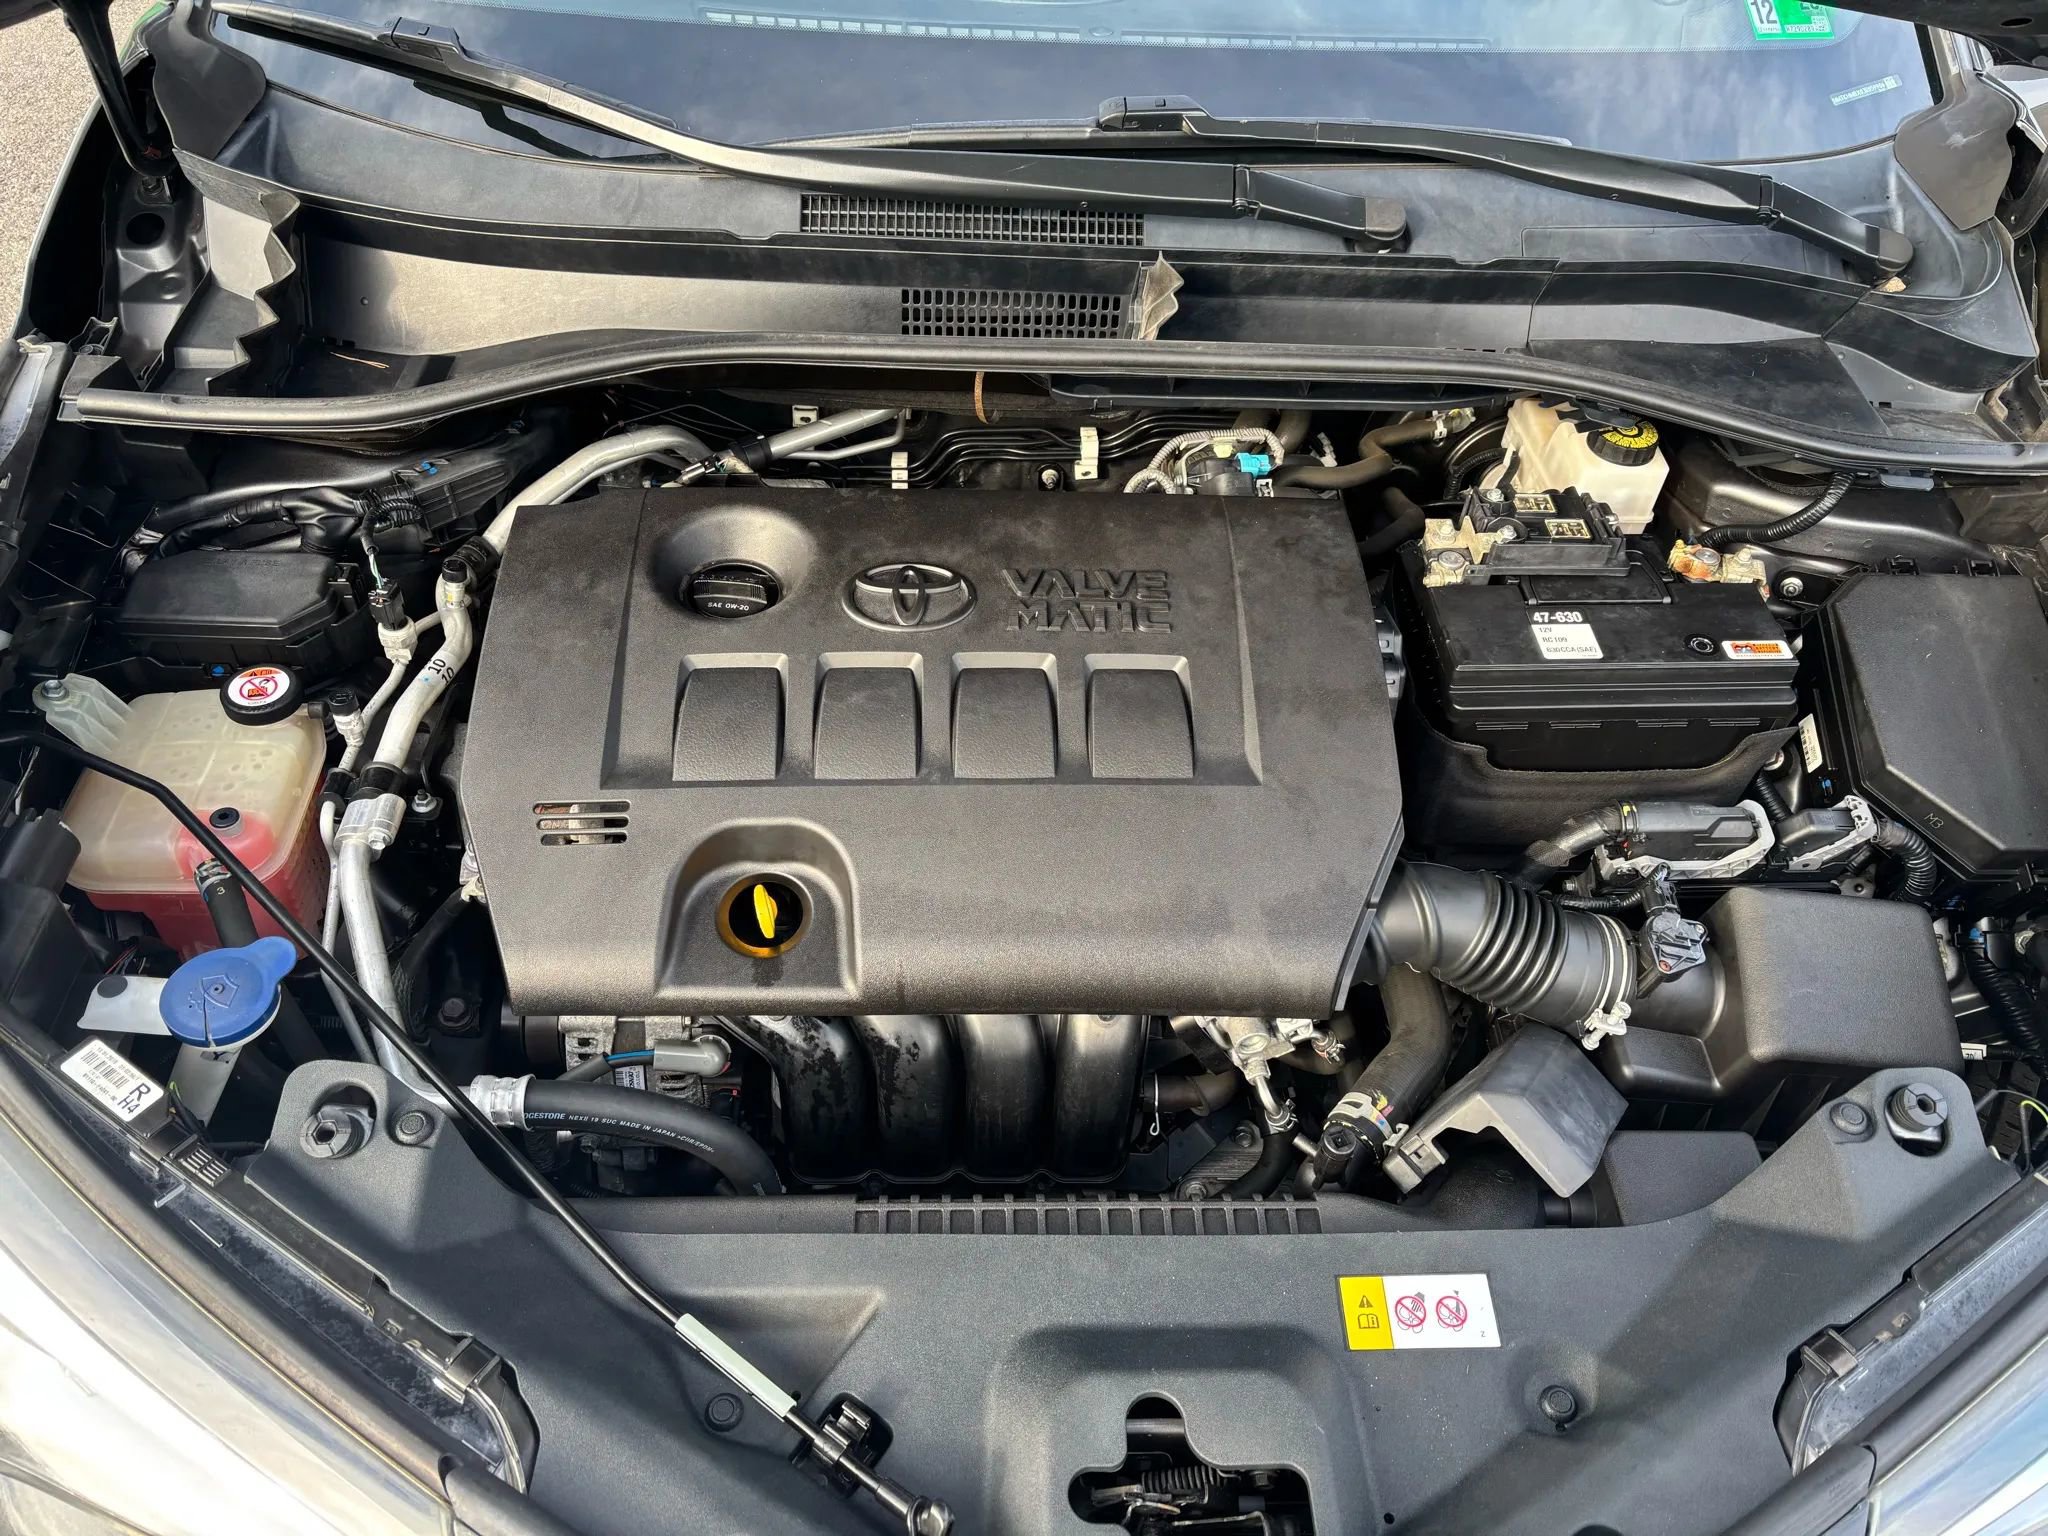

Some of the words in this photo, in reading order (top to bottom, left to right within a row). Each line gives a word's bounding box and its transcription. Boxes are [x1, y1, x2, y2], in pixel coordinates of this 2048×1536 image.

[1750, 0, 1778, 24] 12
[1002, 569, 1169, 600] VALVE
[725, 603, 750, 611] 0W-20
[1006, 600, 1172, 633] MATIC
[1533, 611, 1583, 623] 47-630
[428, 658, 446, 674] 10
[128, 1082, 151, 1102] R
[117, 1095, 141, 1114] H4
[619, 1120, 641, 1129] MADE
[652, 1127, 676, 1138] JAPAN
